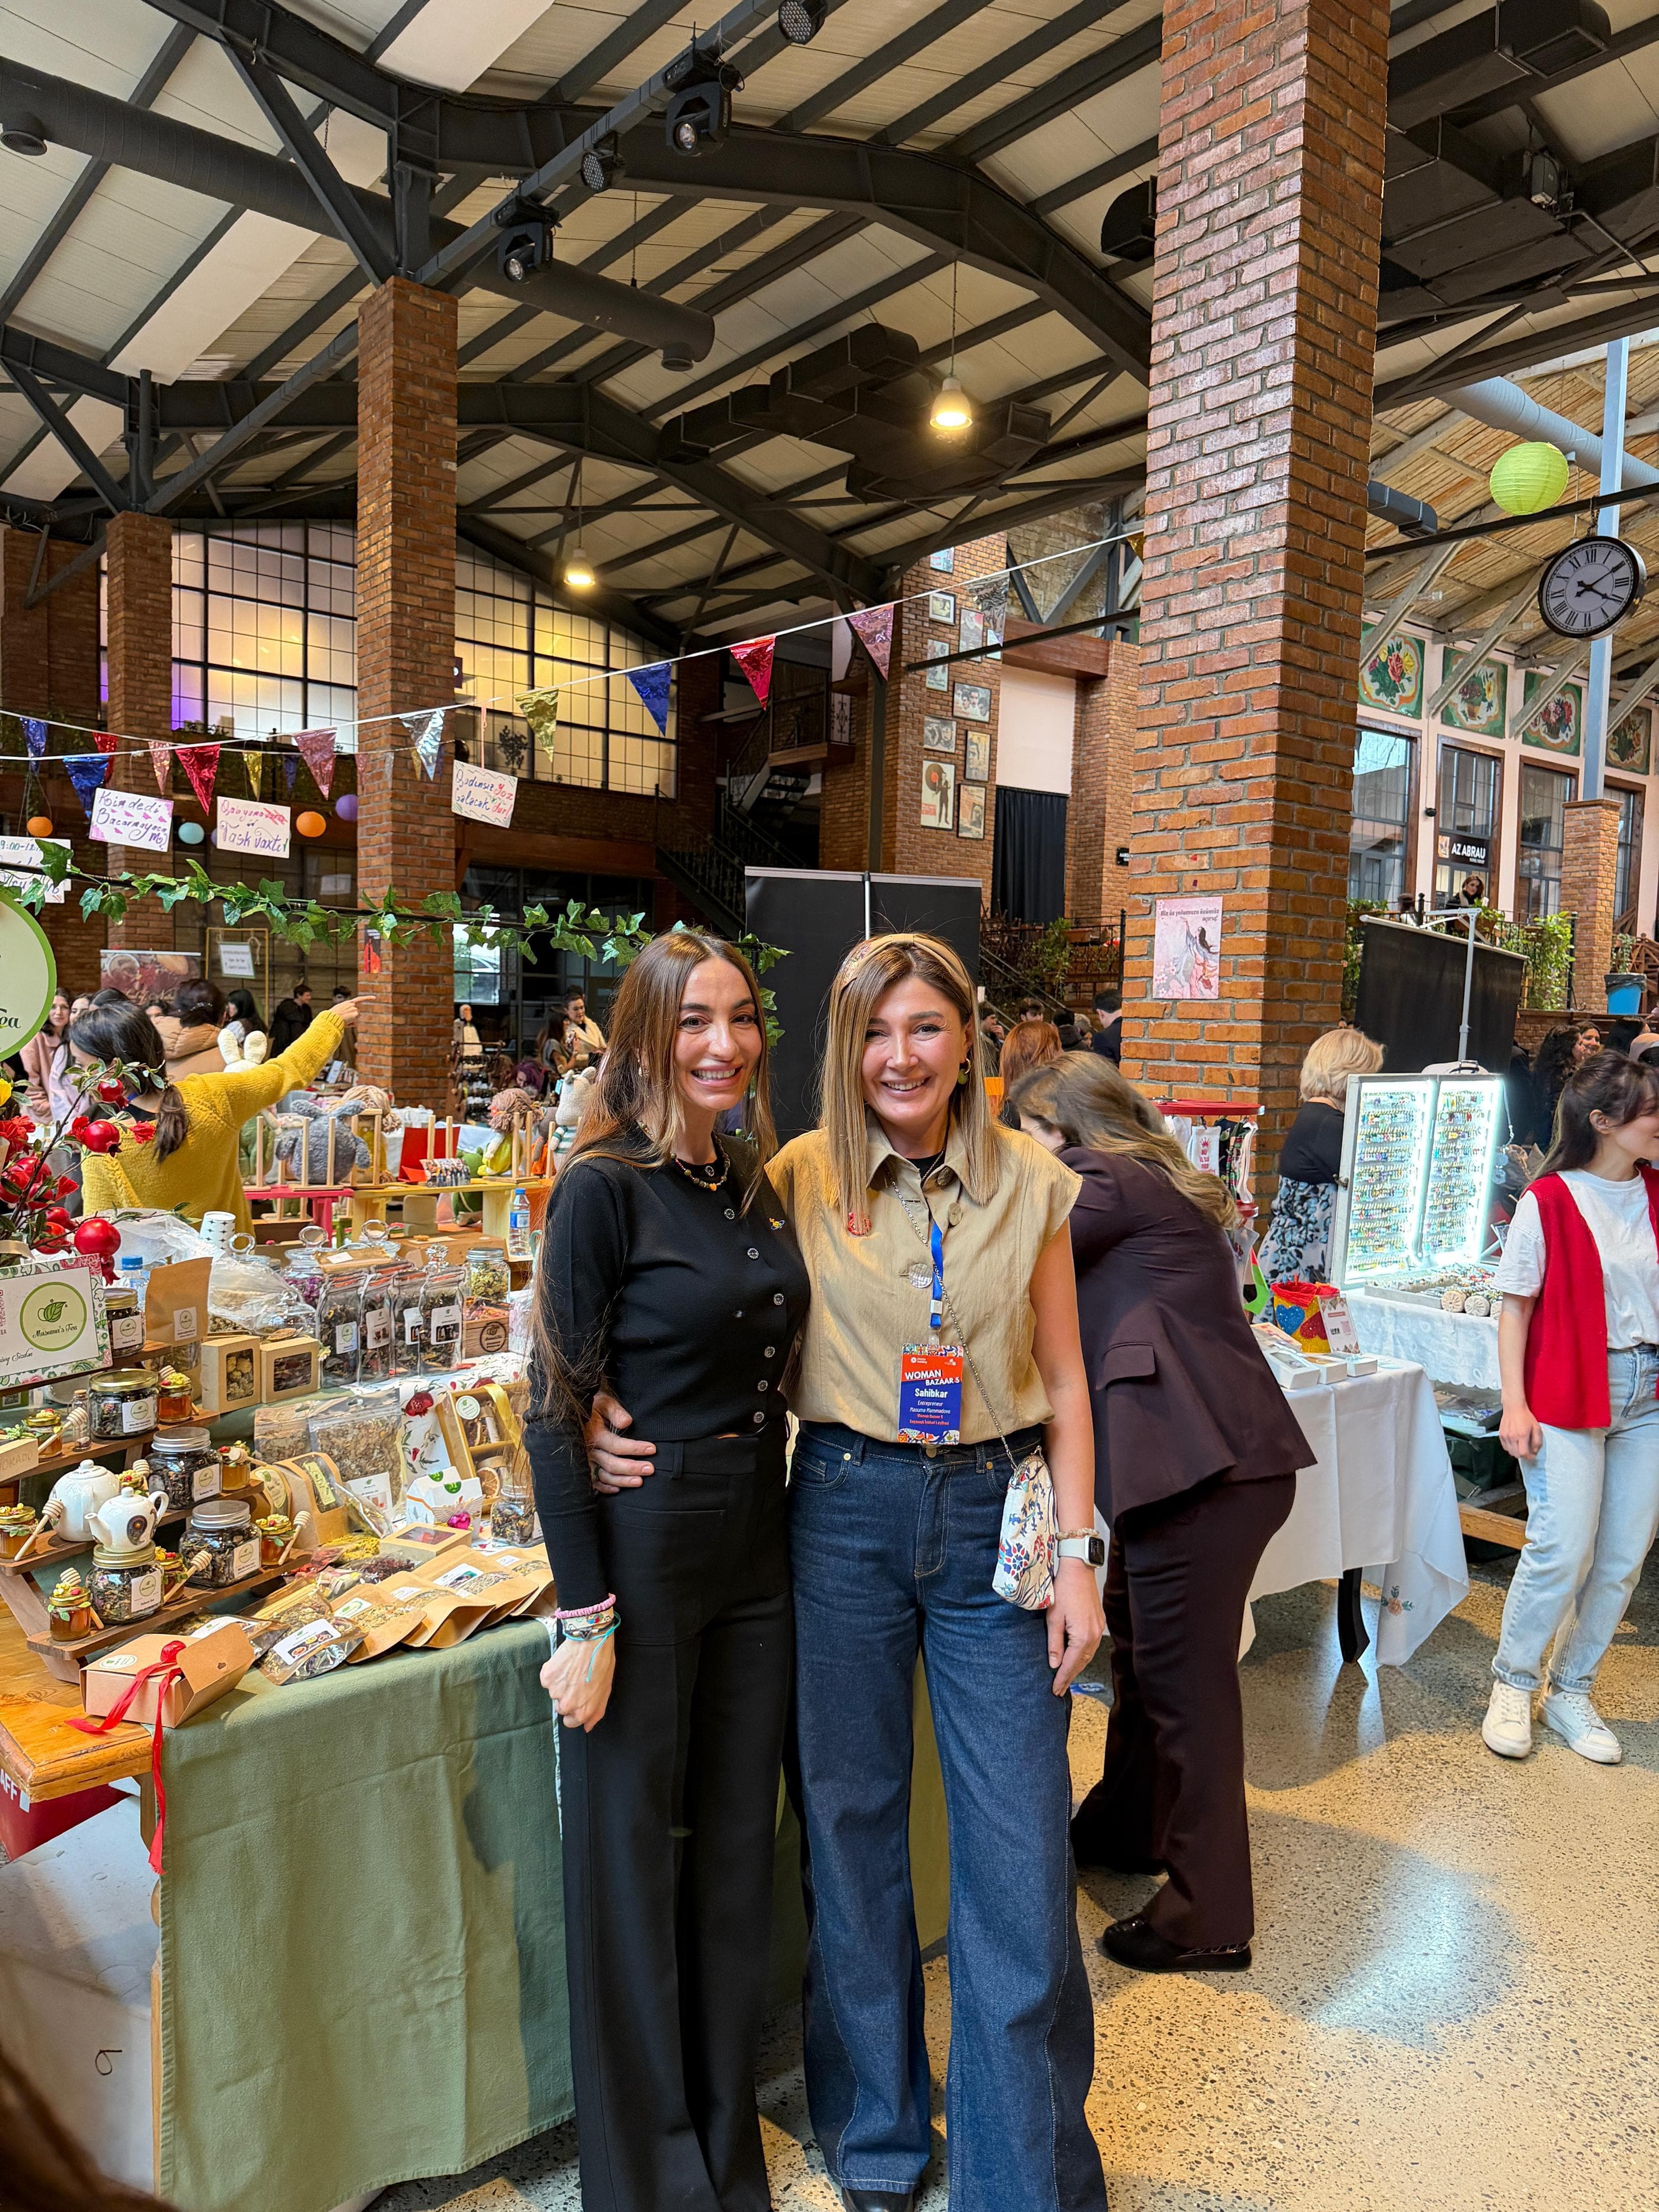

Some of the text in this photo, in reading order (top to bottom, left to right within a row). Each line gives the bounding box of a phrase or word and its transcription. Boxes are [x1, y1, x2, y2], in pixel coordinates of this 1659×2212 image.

[1585, 548, 1597, 564] XII
[1568, 556, 1581, 572] XI
[1614, 577, 1630, 588] III
[1551, 589, 1564, 599] IX
[129, 798, 161, 813] dedi
[1451, 843, 1486, 859] AZ ABRAU
[32, 1323, 77, 1338] Masuma's Tea
[904, 1370, 942, 1380] WOMAN
[915, 1388, 948, 1398] Sahibkar
